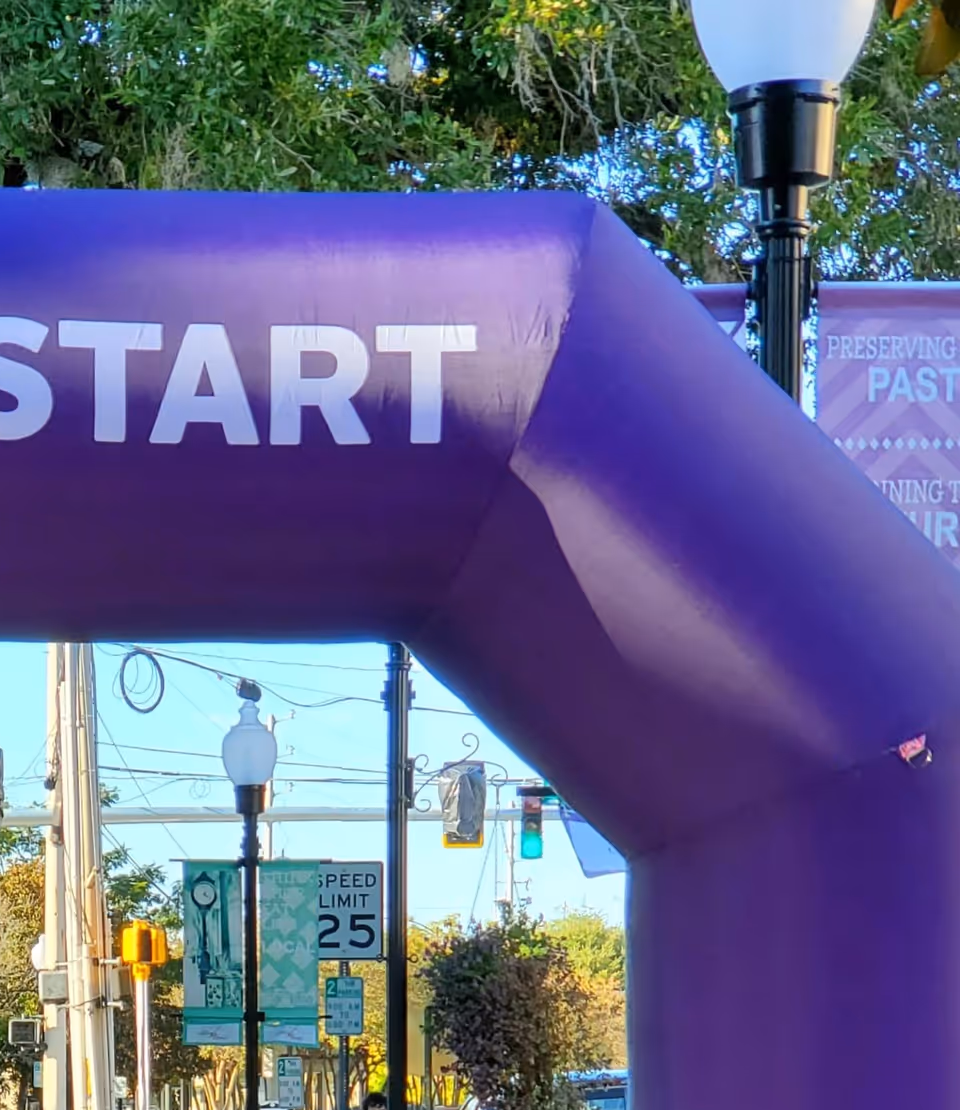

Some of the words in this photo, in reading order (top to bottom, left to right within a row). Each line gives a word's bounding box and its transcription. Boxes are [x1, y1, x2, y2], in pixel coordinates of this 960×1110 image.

[826, 336, 958, 360] PRESERVING
[867, 366, 960, 402] PAST
[319, 893, 370, 908] LIMIT
[318, 913, 376, 949] 25
[327, 980, 337, 995] 2
